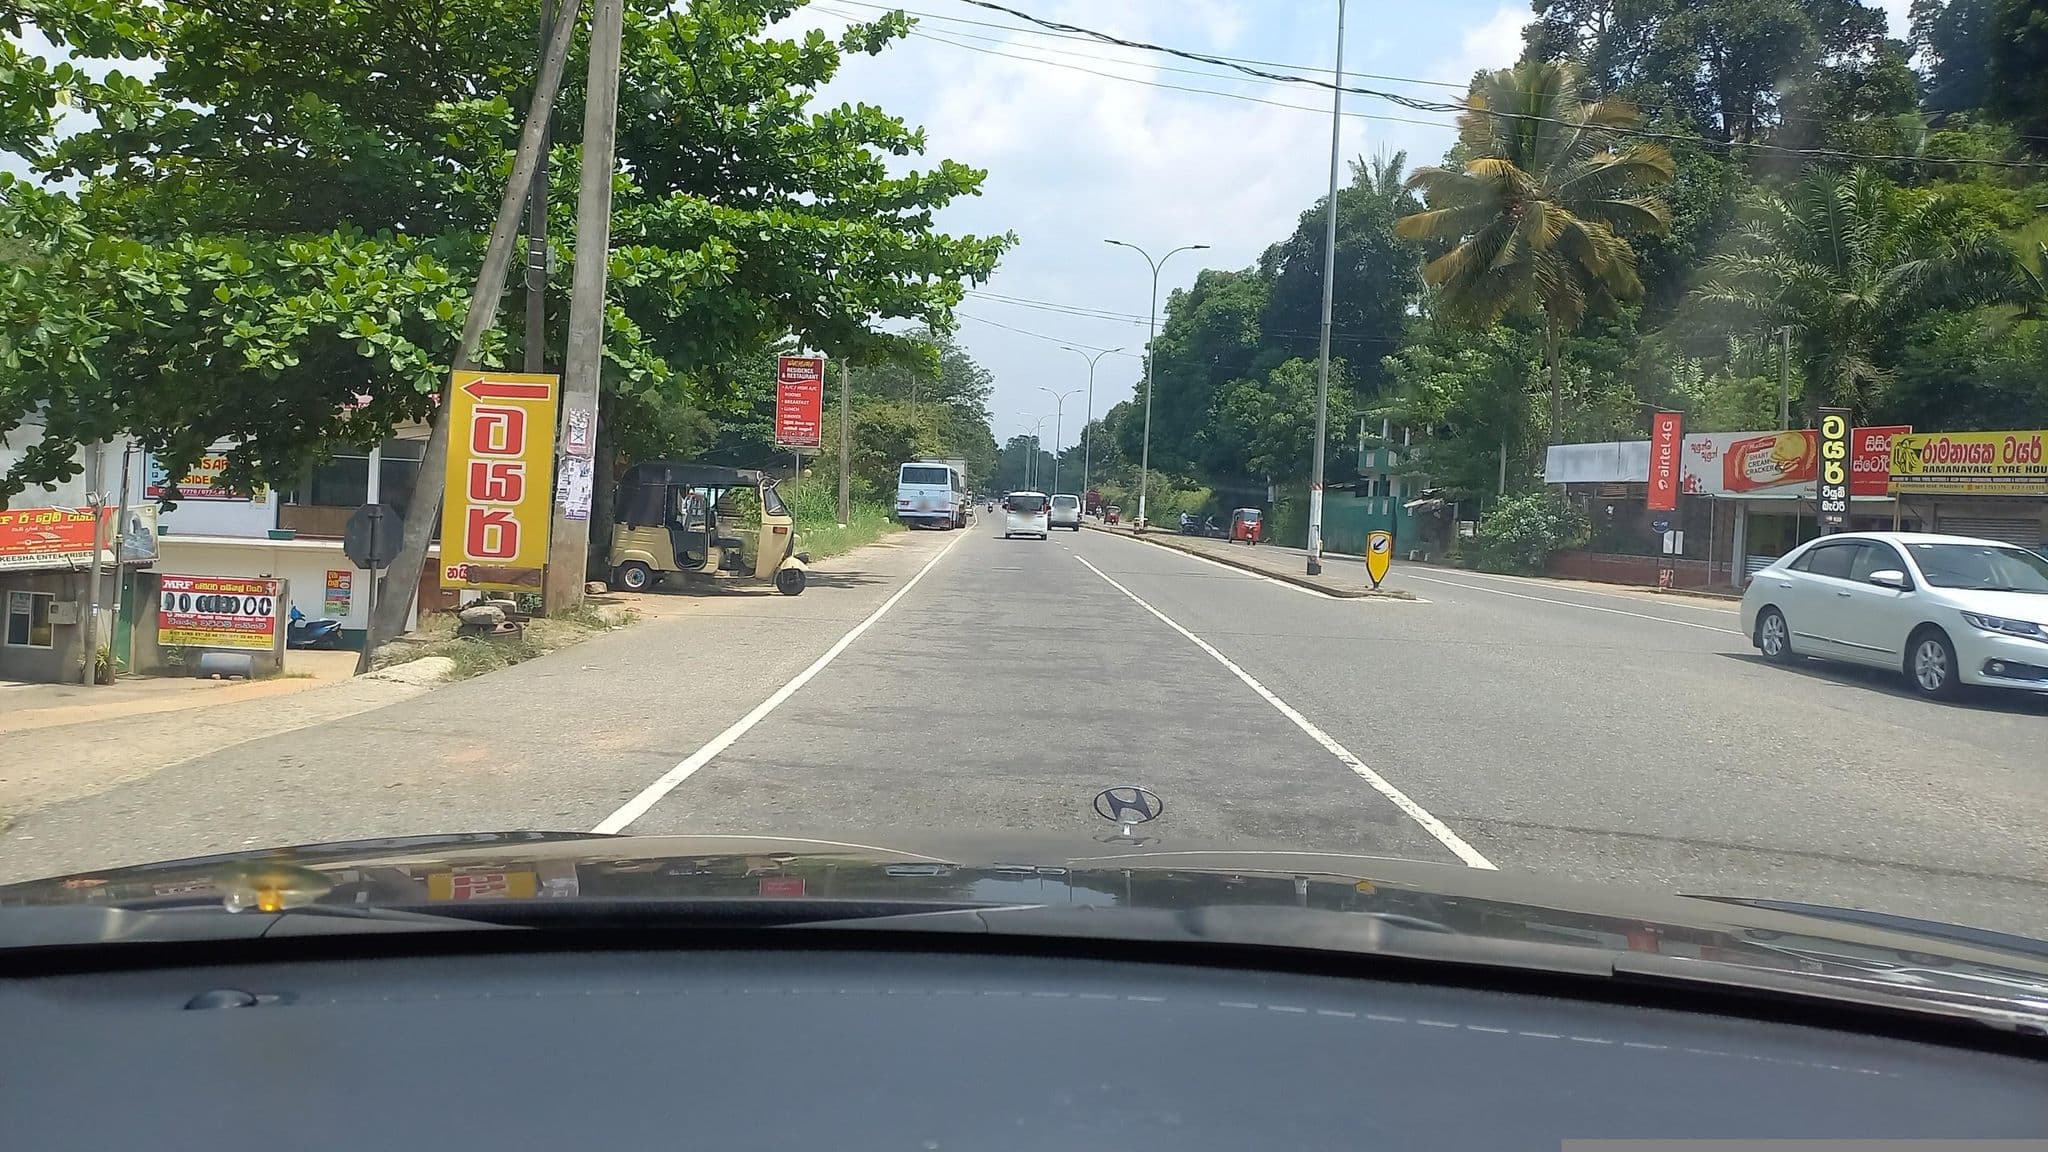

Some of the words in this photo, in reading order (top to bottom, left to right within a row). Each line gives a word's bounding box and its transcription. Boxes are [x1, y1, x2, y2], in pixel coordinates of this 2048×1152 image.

[1661, 421, 1673, 440] 4G
[1822, 415, 1845, 484] ටයර්
[1922, 437, 1996, 464] රාමනායක
[1658, 441, 1672, 477] airtel
[1749, 451, 1769, 461] SMART
[1748, 459, 1770, 468] CREAM
[1745, 465, 1775, 476] CRACKER
[1922, 465, 1993, 474] RAMANAYAKE
[1996, 465, 2022, 474] TYRE
[163, 580, 193, 589] MRF
